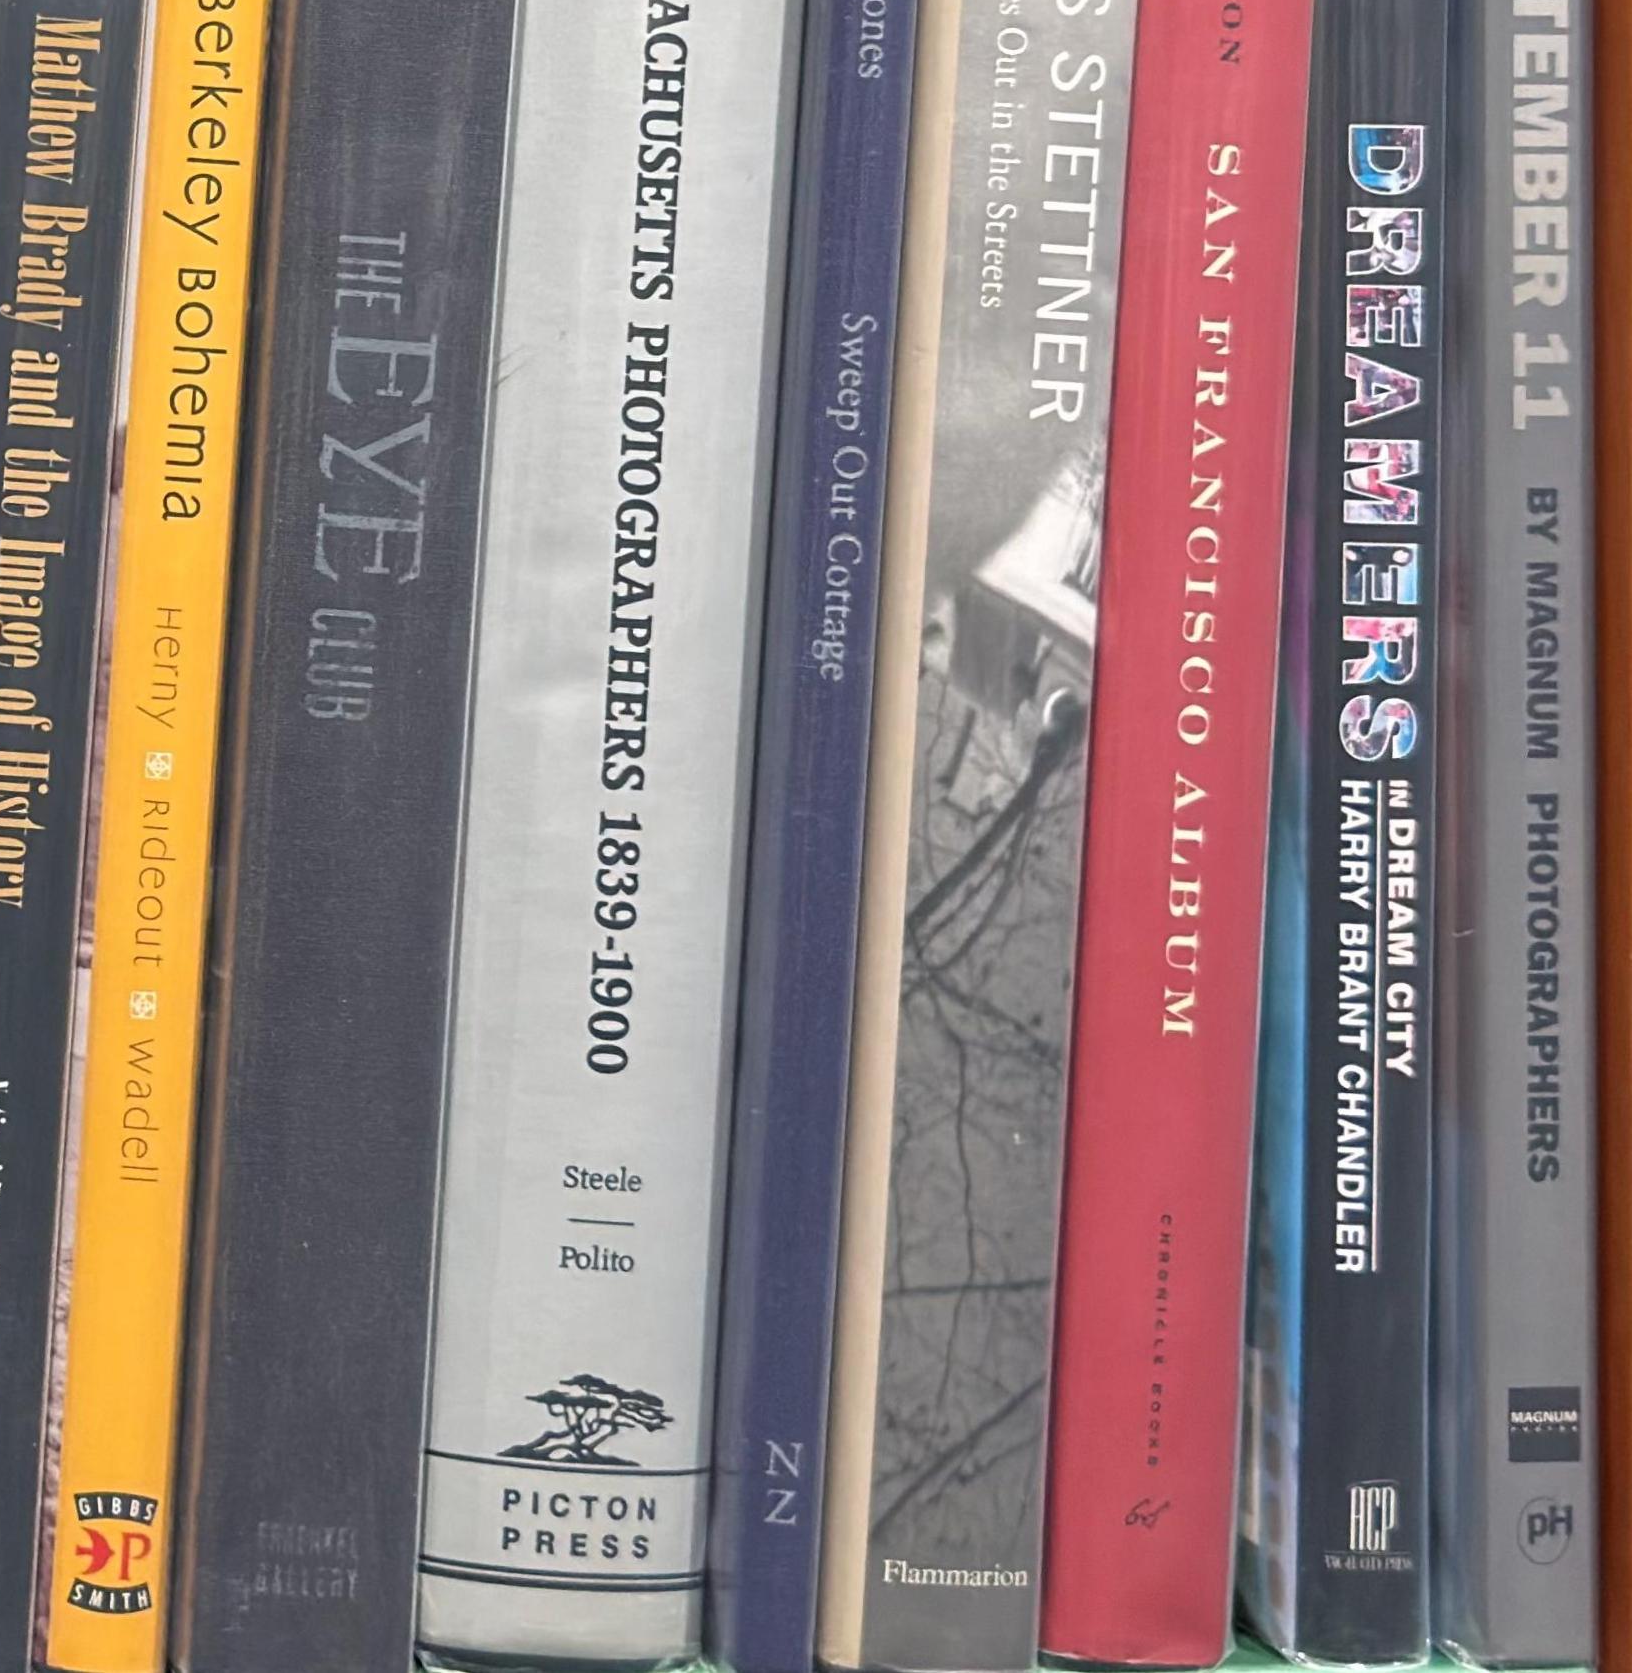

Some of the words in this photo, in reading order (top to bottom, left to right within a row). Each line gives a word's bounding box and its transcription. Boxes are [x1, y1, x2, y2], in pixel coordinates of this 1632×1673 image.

[25, 13, 103, 186] Mathew
[993, 26, 1029, 89] Out
[987, 101, 1024, 130] in
[987, 141, 1022, 191] the
[0, 200, 89, 332] Brady
[980, 201, 1017, 309] Streets
[1028, 50, 1106, 423] STETTNER
[1201, 142, 1241, 284] SAN
[334, 231, 406, 315] THE
[6, 348, 75, 429] and
[162, 267, 228, 521] Bohemia
[825, 311, 877, 433] Sweep
[1512, 332, 1571, 430] 11
[1, 446, 72, 520] the
[313, 325, 437, 585] EYE
[830, 446, 869, 522] Out
[1339, 124, 1425, 762] DREAMERS
[600, 321, 670, 792] PHOTOGRAPHERS
[1177, 313, 1233, 746] FRANCISCO
[811, 533, 863, 682] Cottage
[136, 606, 184, 729] Herny
[304, 607, 377, 722] CLUB
[1388, 779, 1411, 808] IN
[133, 797, 177, 969] Rideout
[1162, 770, 1210, 1039] ALBUM
[1387, 817, 1418, 967] DREAM
[586, 810, 644, 1075] 1839-1900
[1386, 981, 1418, 1078] CITY
[563, 1165, 643, 1193] Steele
[558, 1245, 635, 1274] Polito
[1152, 1213, 1173, 1366] CHRONICLE
[1511, 1411, 1577, 1423] MAGNUM
[77, 1496, 155, 1522] GIBBS
[1349, 1486, 1397, 1551] ACP
[72, 1583, 149, 1610] SMITH
[882, 1559, 1029, 1588] Flammarion
